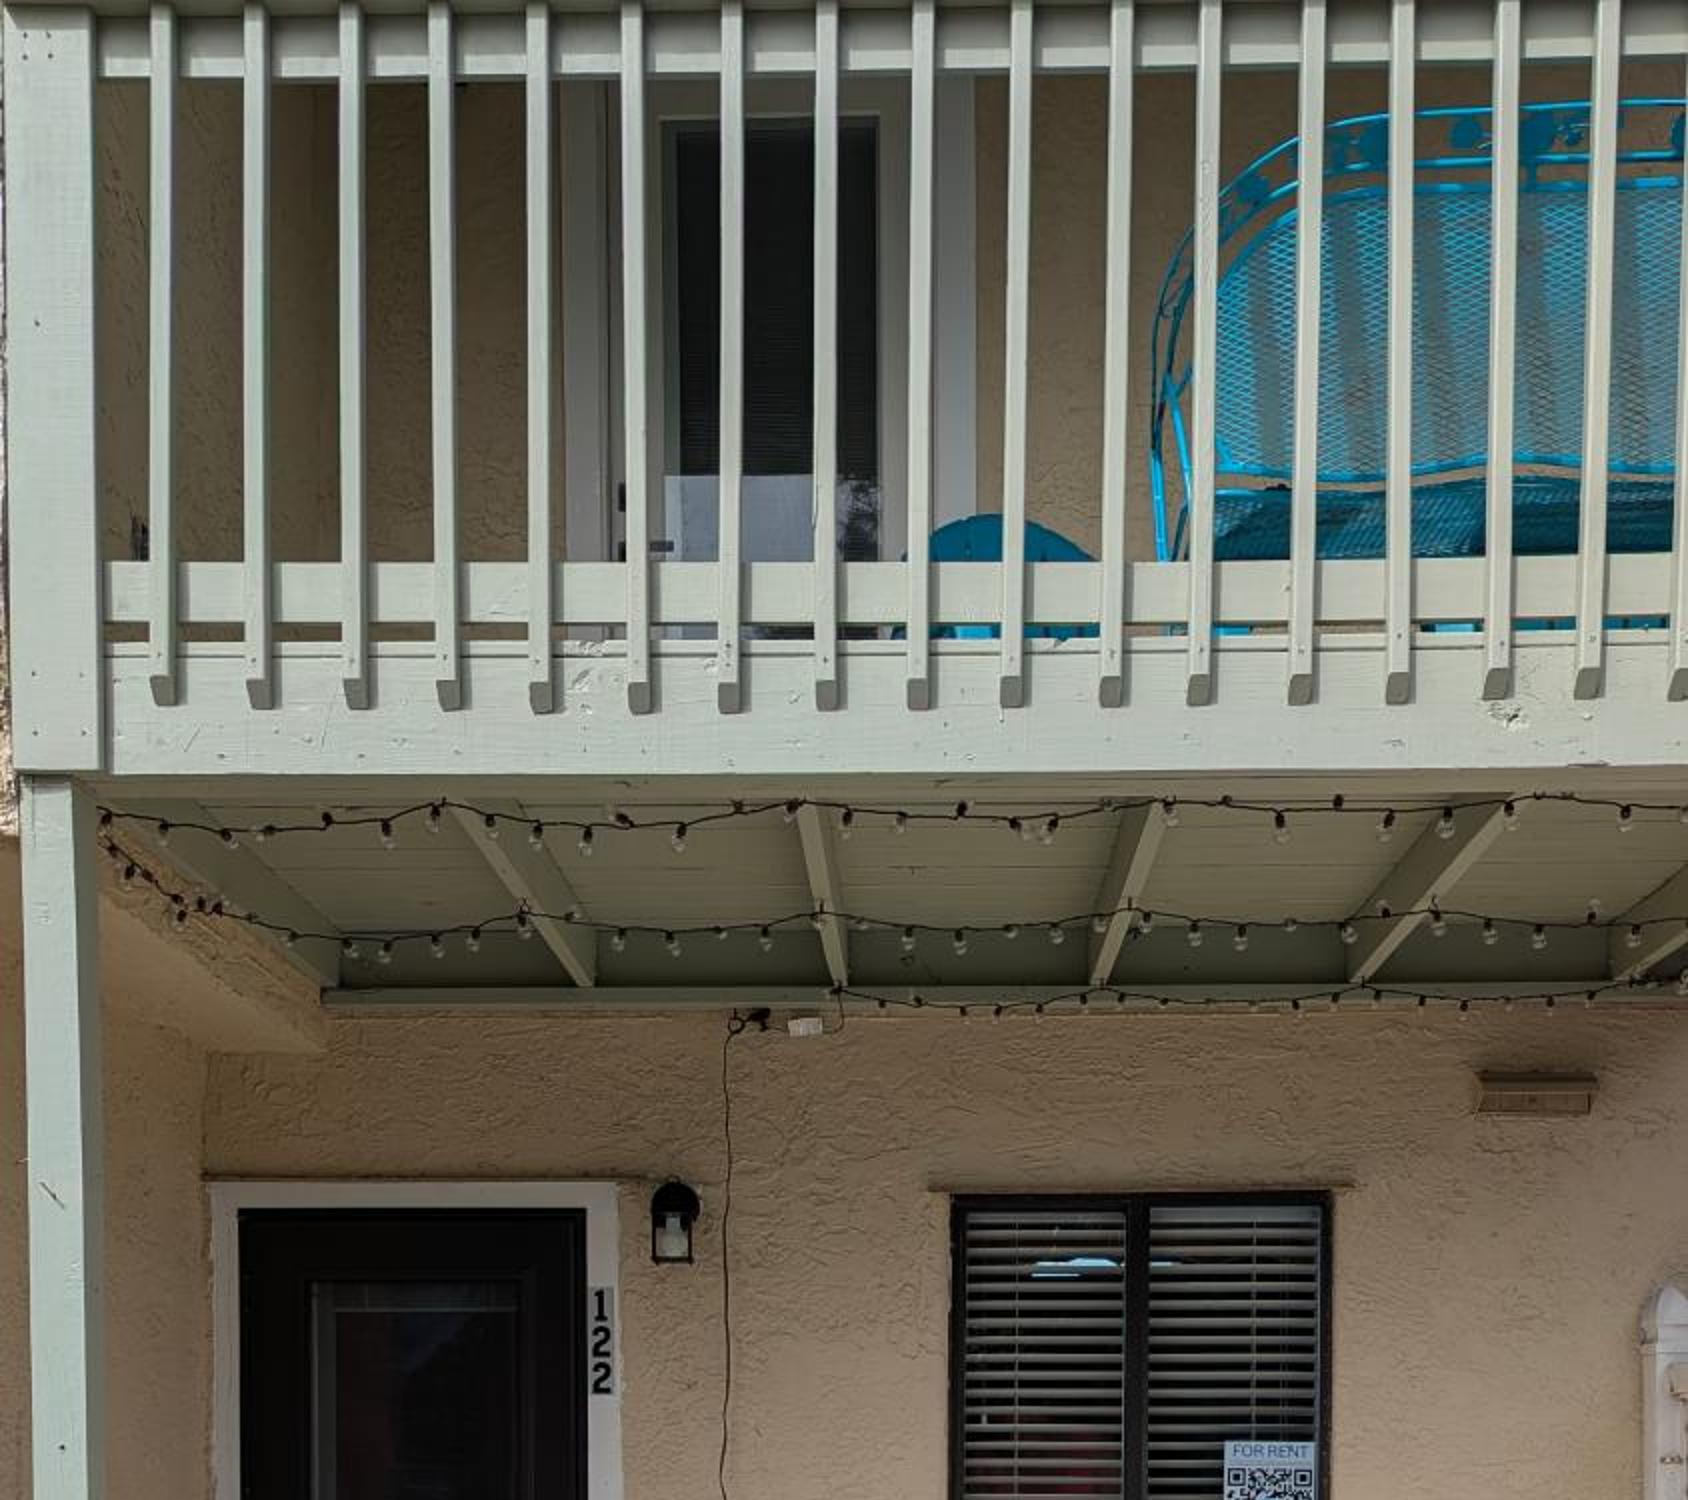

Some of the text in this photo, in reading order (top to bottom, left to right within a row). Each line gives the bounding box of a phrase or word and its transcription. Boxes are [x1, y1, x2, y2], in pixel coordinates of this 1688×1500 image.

[591, 1288, 612, 1395] 122
[1233, 1444, 1309, 1458] FOR RENT
